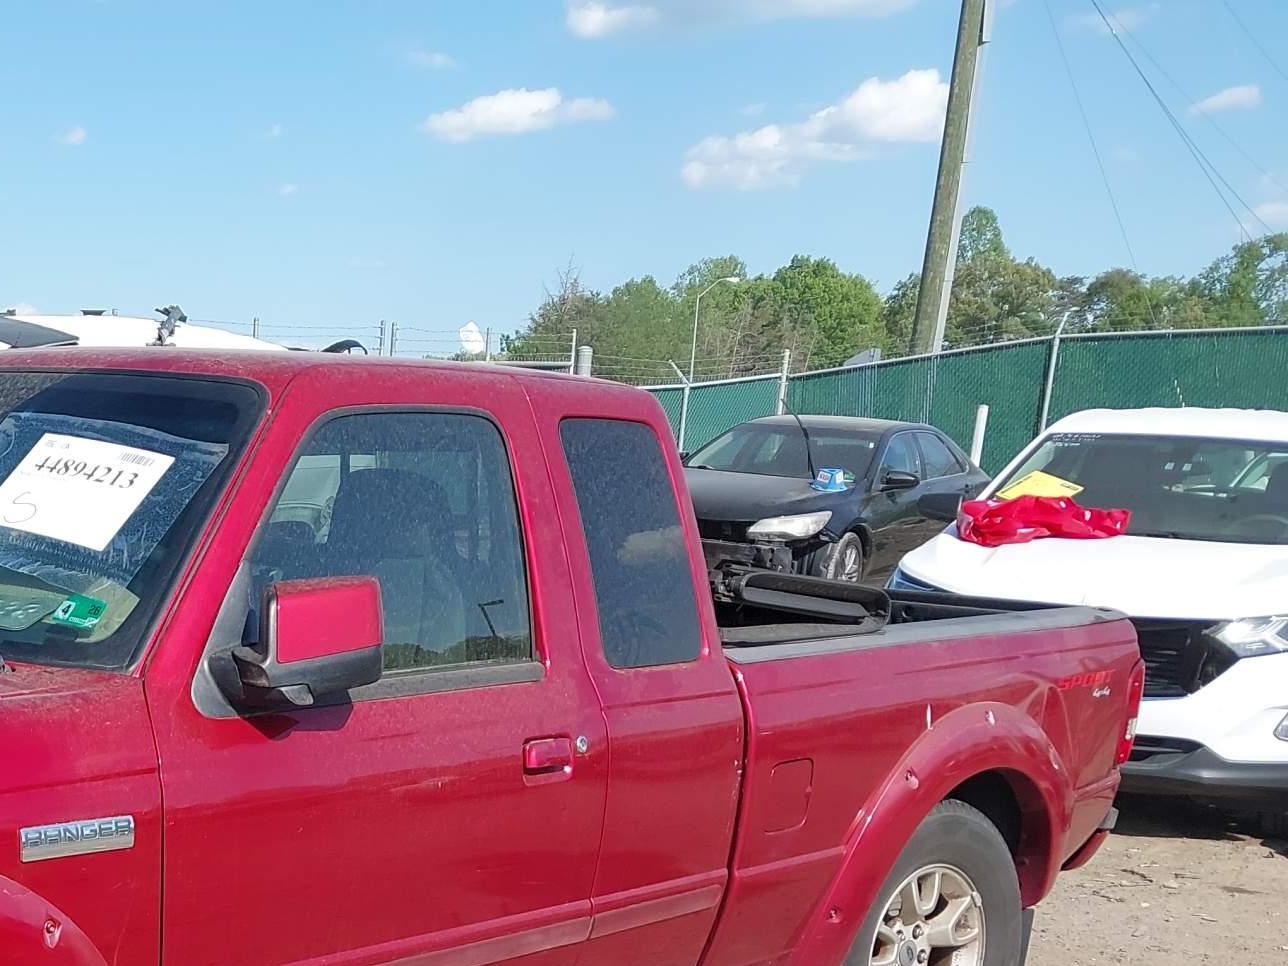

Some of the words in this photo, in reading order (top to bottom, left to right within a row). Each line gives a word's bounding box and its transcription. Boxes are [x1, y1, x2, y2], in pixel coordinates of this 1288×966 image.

[35, 456, 139, 489] 44894213
[62, 604, 72, 615] 4
[1058, 671, 1113, 689] SPORT
[22, 818, 132, 849] RANGER
